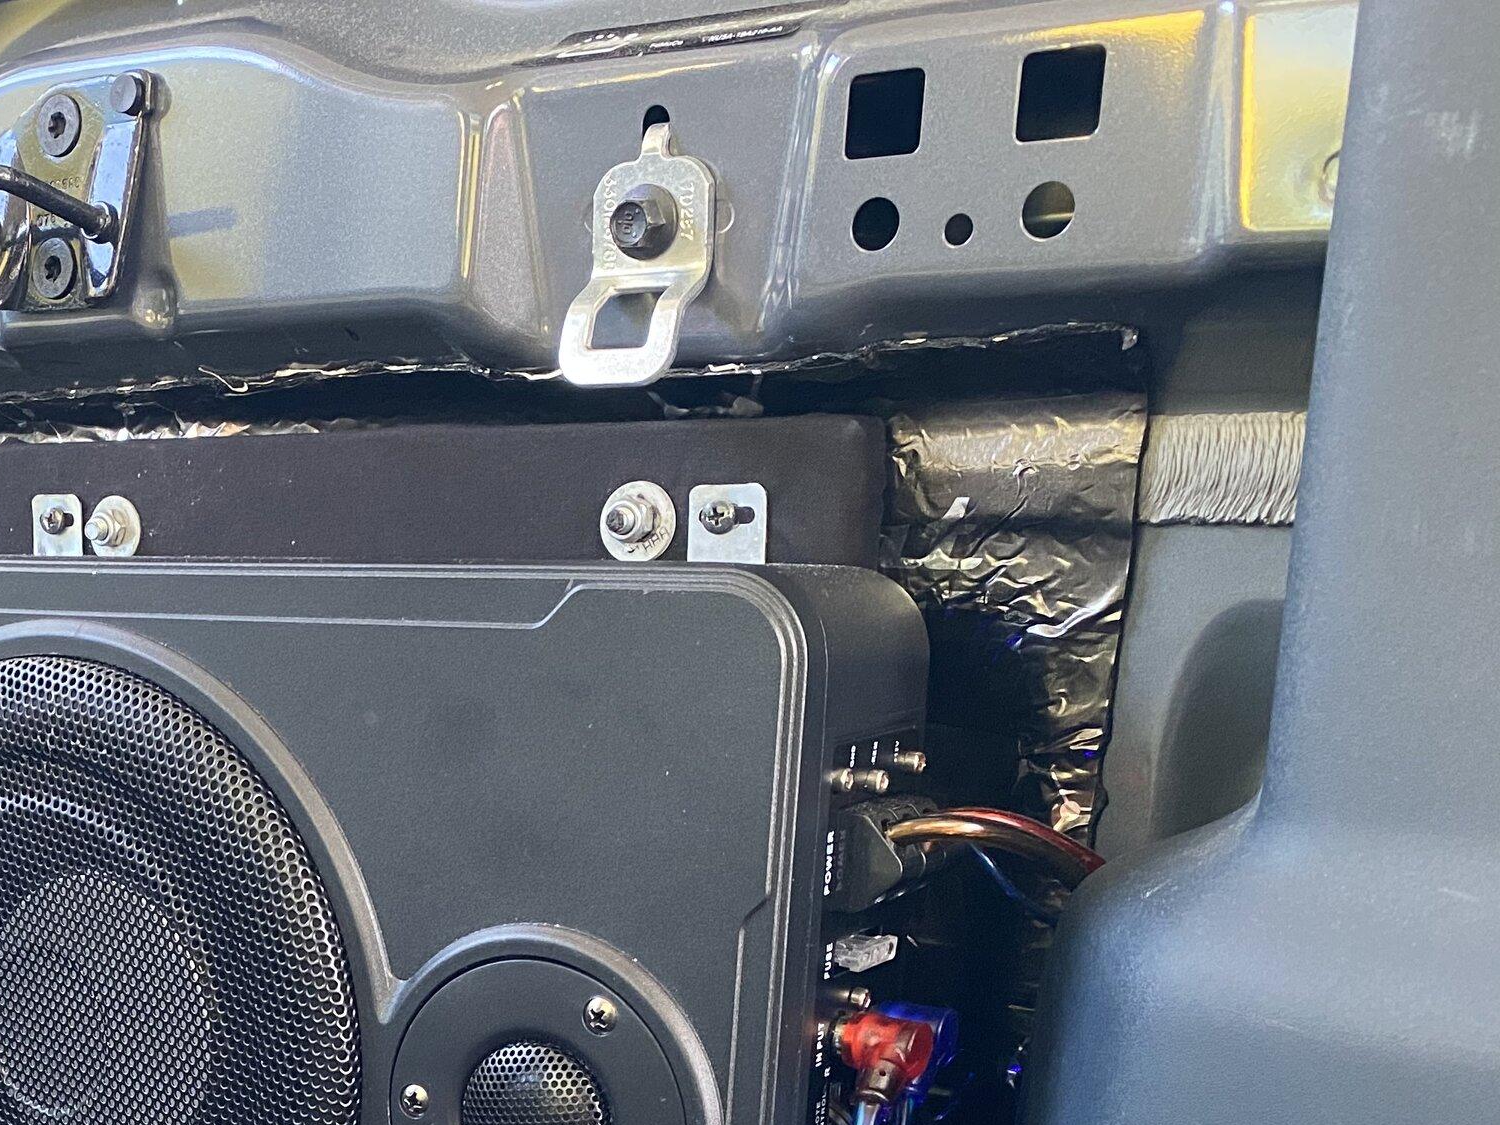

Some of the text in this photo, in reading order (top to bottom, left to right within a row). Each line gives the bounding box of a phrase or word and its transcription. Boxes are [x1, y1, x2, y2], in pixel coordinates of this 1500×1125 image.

[823, 830, 835, 896] POWER
[823, 942, 834, 980] FUSE
[814, 1022, 826, 1068] INPUT
